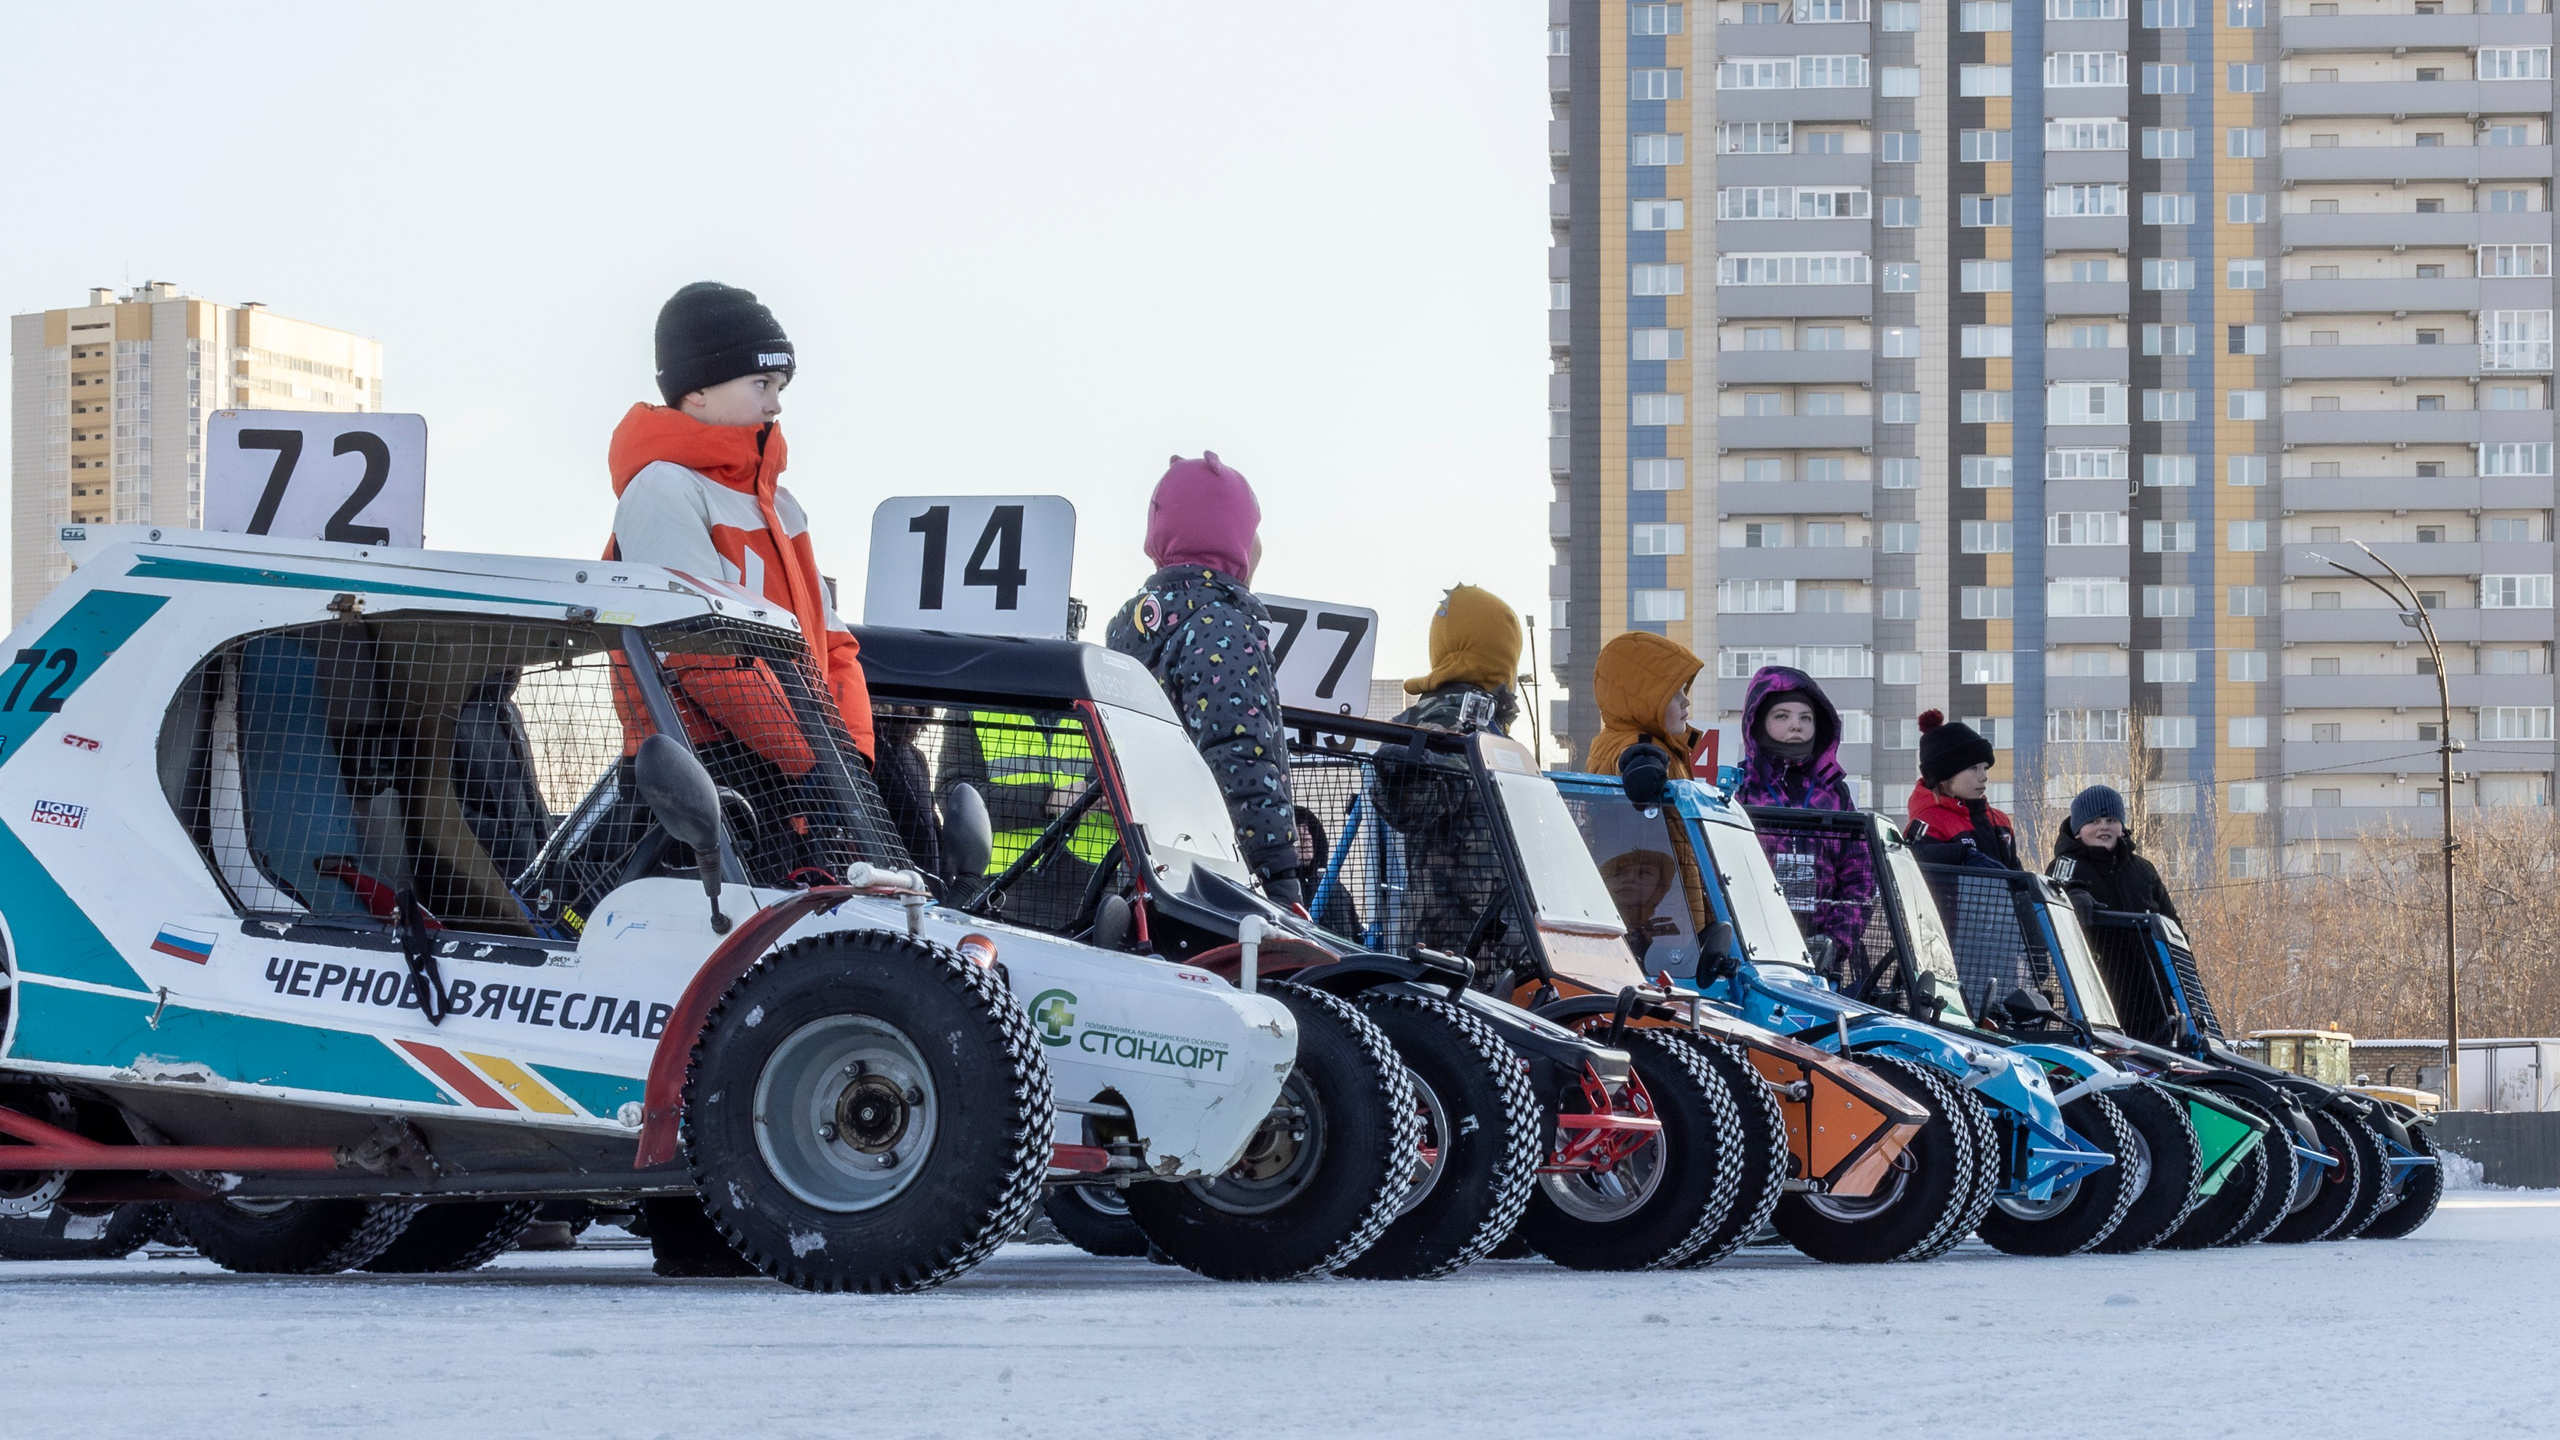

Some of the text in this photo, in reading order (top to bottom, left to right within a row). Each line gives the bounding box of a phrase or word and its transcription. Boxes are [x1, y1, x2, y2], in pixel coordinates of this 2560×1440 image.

[758, 352, 788, 367] PUMA
[237, 428, 390, 546] 72
[908, 505, 1027, 610] 14
[1, 647, 78, 713] 72
[1262, 605, 1369, 699] 77
[32, 811, 80, 828] MOLY
[36, 801, 81, 818] LIQUI
[265, 956, 675, 1040] ЧЕРНОВ ВЯЧЕСЛАВ
